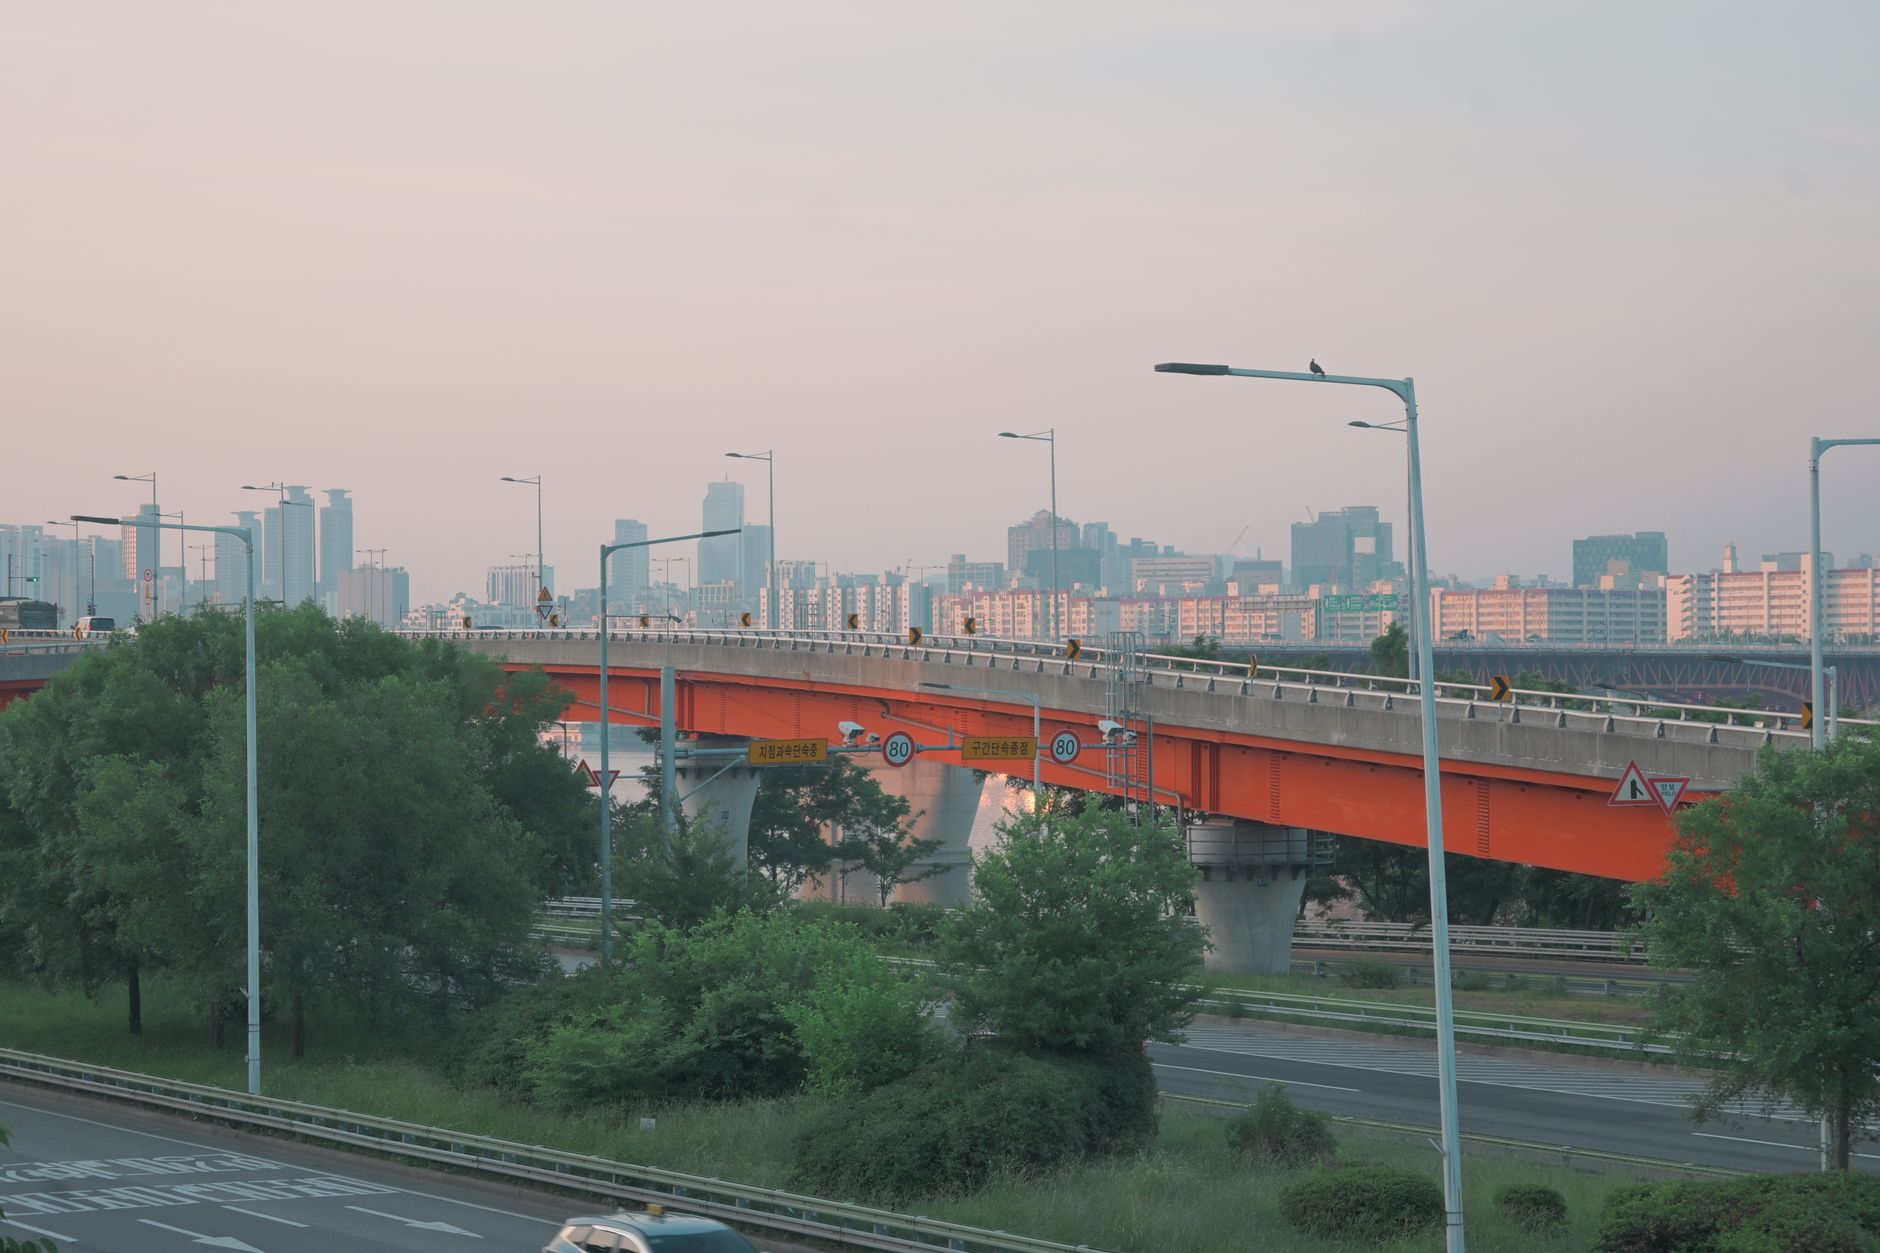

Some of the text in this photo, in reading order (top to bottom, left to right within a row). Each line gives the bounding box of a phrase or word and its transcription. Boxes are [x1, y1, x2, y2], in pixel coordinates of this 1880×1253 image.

[758, 743, 818, 759] 지점과속단속중
[889, 741, 909, 757] 80
[971, 741, 1029, 756] 구간단속종점
[1056, 739, 1075, 755] 80
[152, 1176, 400, 1202] 마포대교
